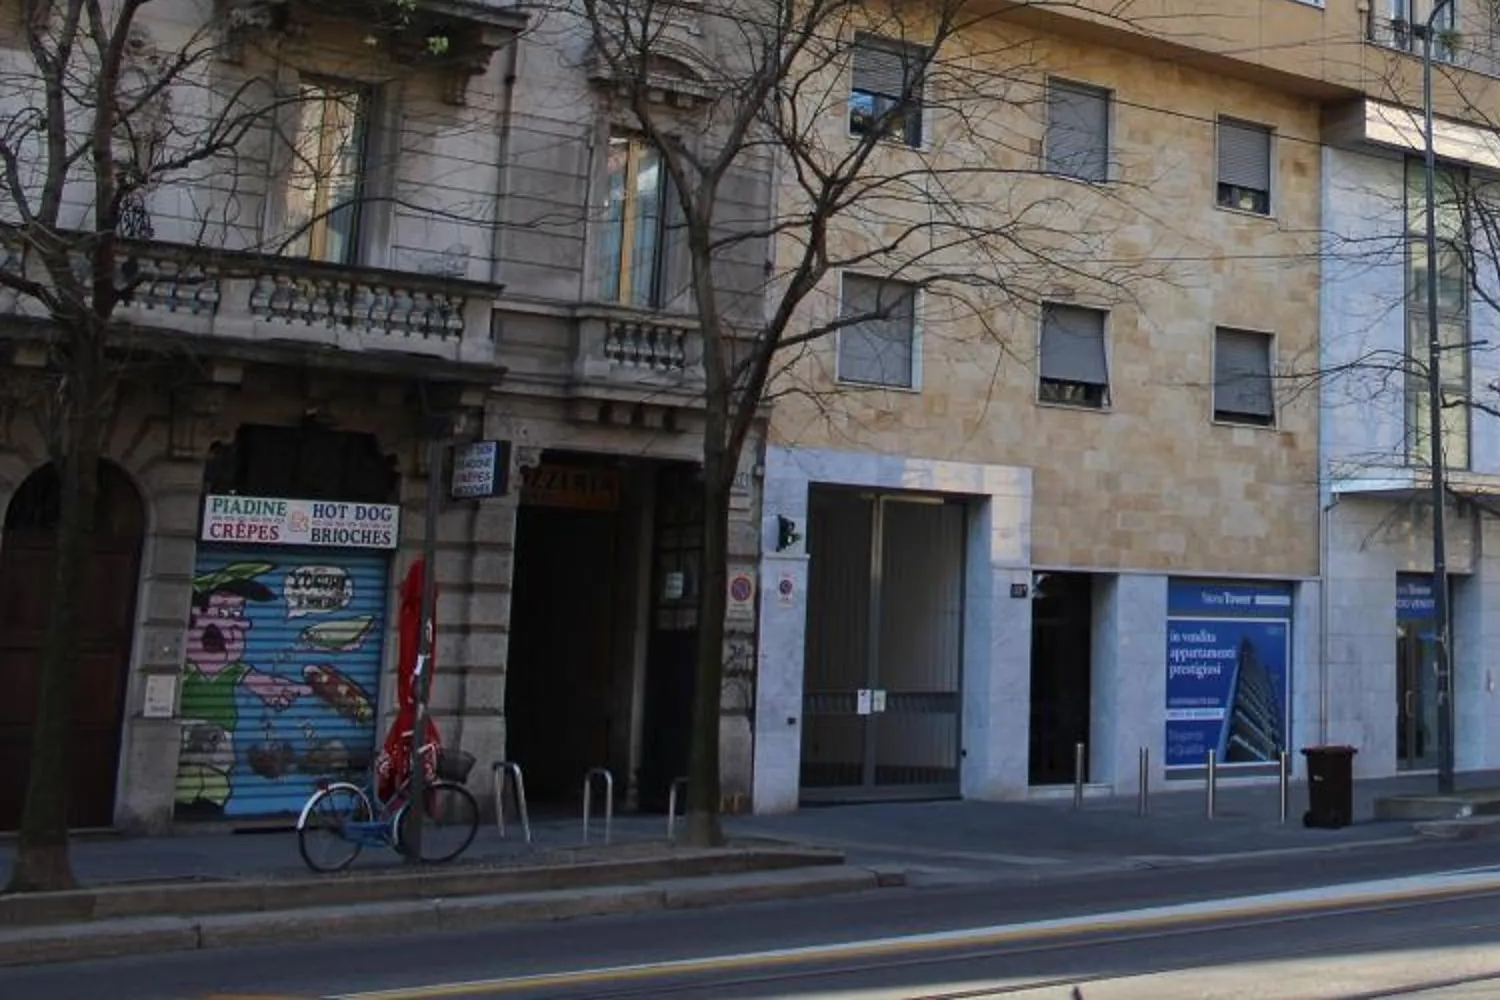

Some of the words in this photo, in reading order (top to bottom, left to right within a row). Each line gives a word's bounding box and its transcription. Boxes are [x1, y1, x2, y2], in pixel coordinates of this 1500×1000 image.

[211, 498, 288, 517] PIADINE
[312, 503, 348, 519] HOT
[355, 505, 392, 521] DOG
[311, 527, 392, 546] BRIOCHES
[1182, 629, 1217, 643] vendita
[1170, 645, 1236, 662] appartamenti
[1169, 662, 1221, 680] prestigiosi
